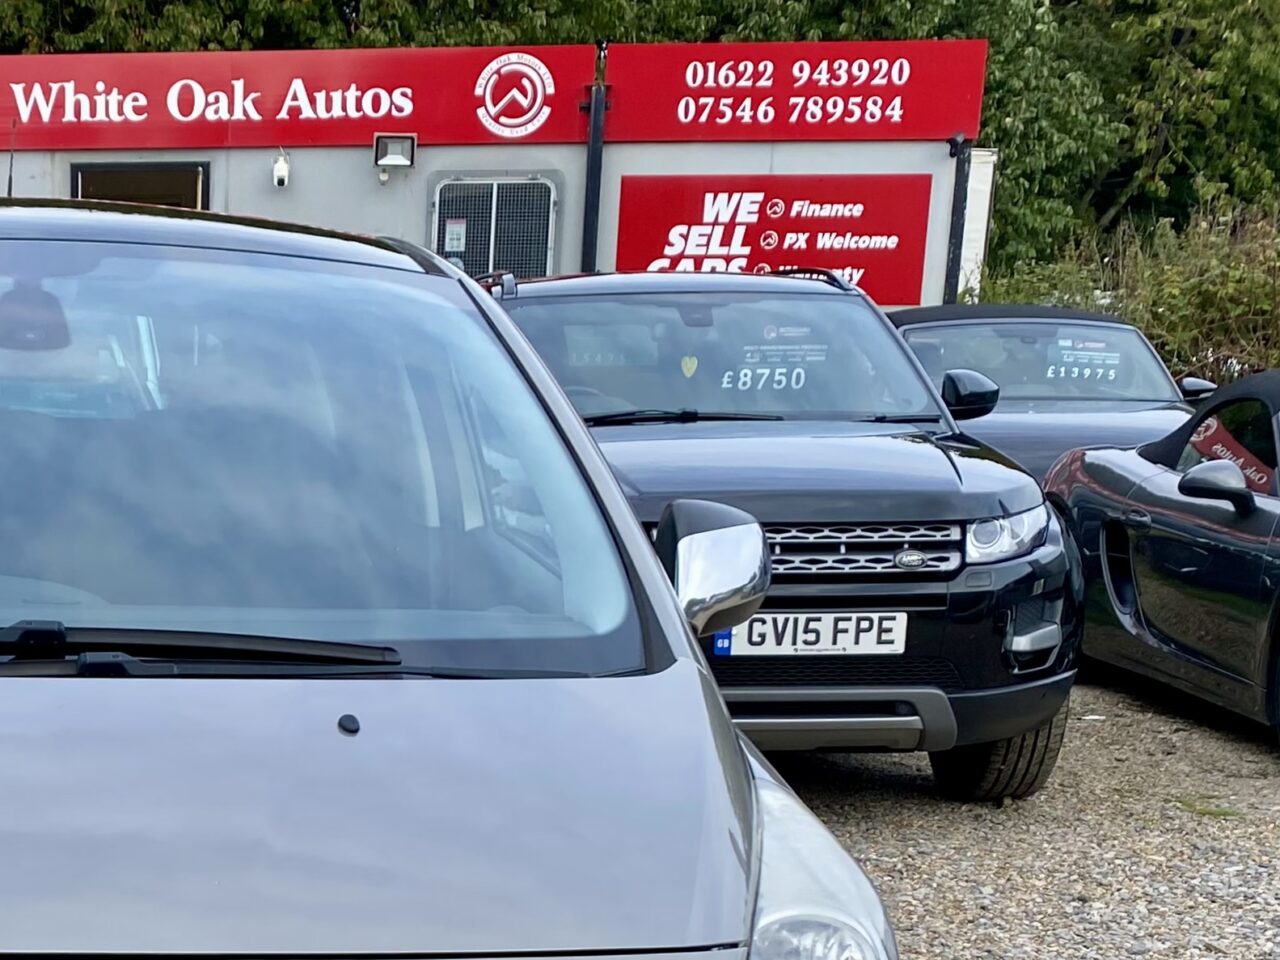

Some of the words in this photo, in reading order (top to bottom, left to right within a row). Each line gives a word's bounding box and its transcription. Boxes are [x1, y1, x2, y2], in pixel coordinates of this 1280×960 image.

[685, 60, 774, 88] 01622
[791, 58, 910, 87] 943920
[9, 80, 148, 124] White
[166, 78, 262, 121] Oak
[276, 78, 414, 120] Autos
[677, 96, 775, 124] 07546
[788, 95, 903, 123] 789584
[702, 192, 765, 223] WE
[790, 200, 864, 218] Finance
[663, 225, 751, 256] SELL
[783, 232, 809, 249] PX
[816, 232, 899, 249] Welcome
[721, 367, 806, 390] £8750
[1046, 365, 1116, 380] £13975
[747, 616, 822, 646] GV15
[832, 615, 897, 646] FPE
